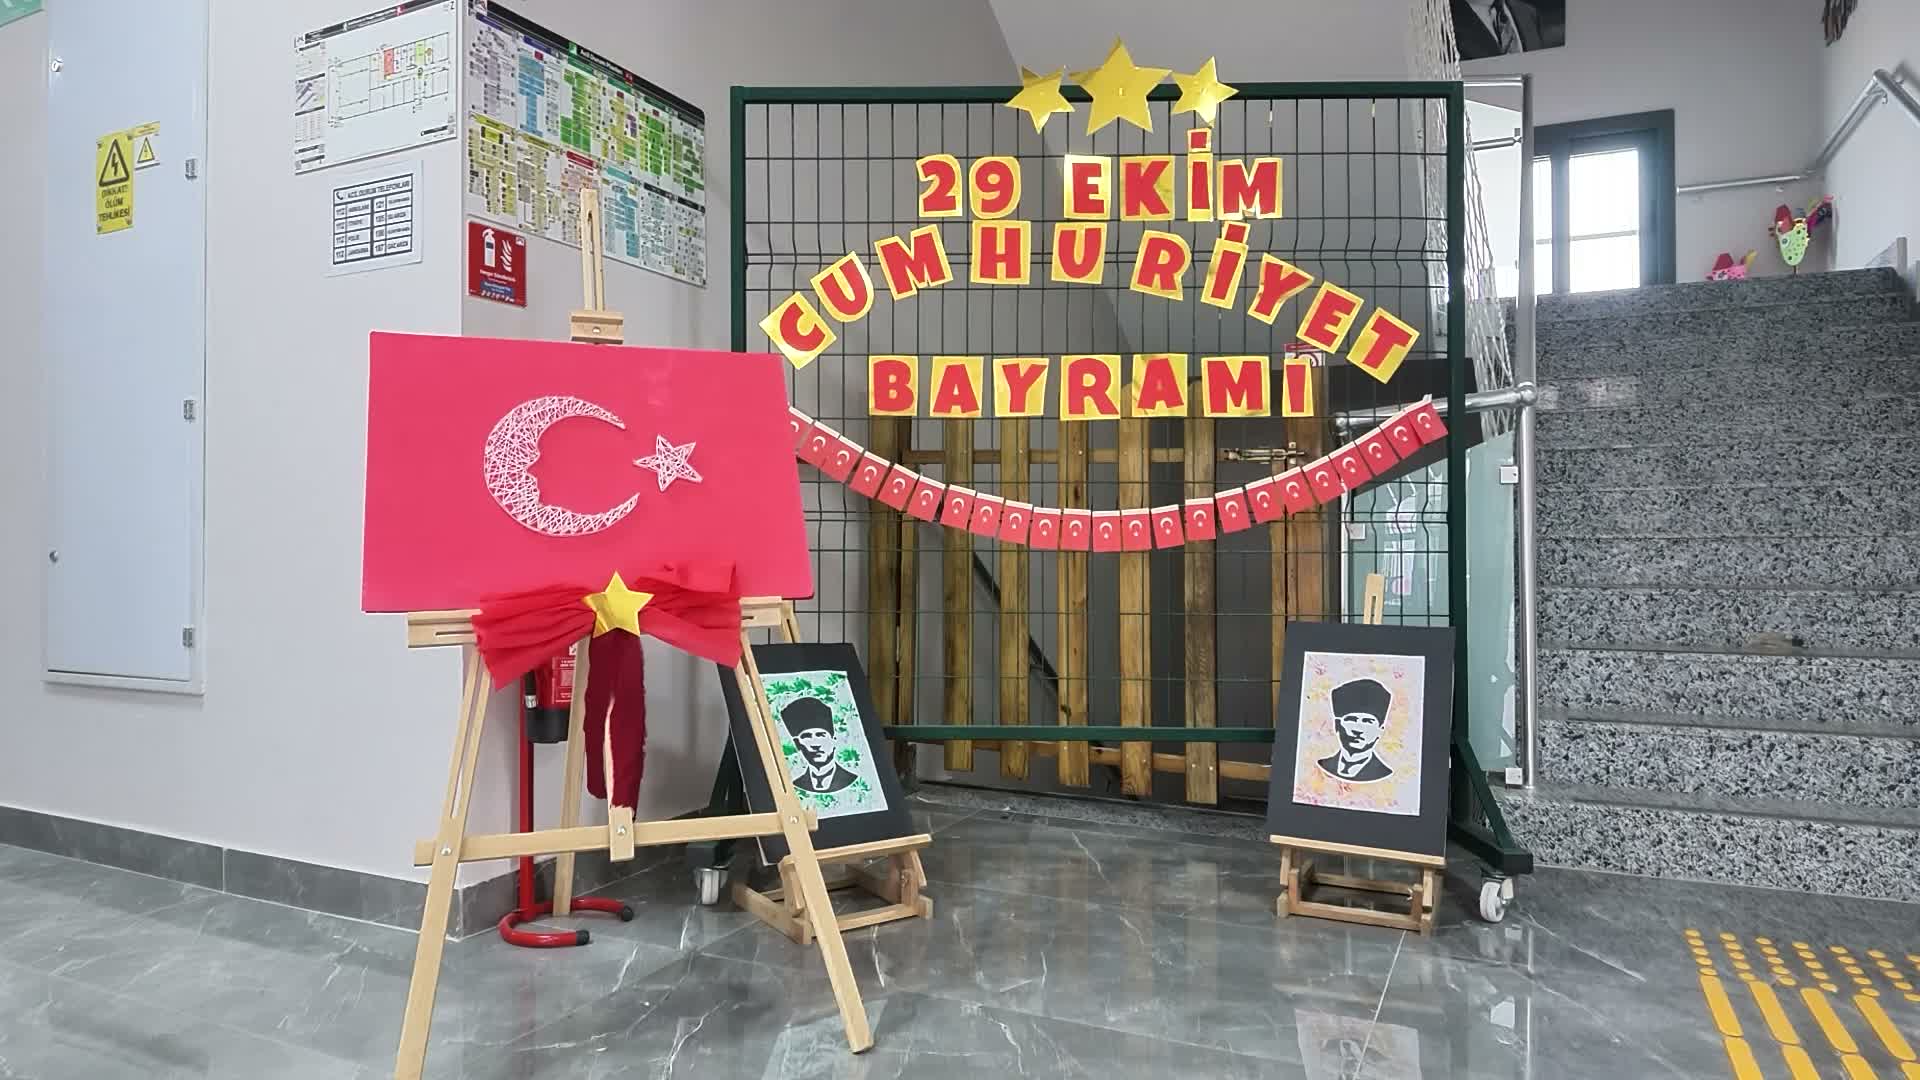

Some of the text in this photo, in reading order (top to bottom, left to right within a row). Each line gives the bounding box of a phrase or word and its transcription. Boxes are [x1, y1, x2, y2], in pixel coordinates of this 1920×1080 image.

[920, 130, 1279, 217] 29 EKİM
[777, 223, 1411, 370] CUMHURİYET
[872, 357, 1307, 414] BAYRAMI
